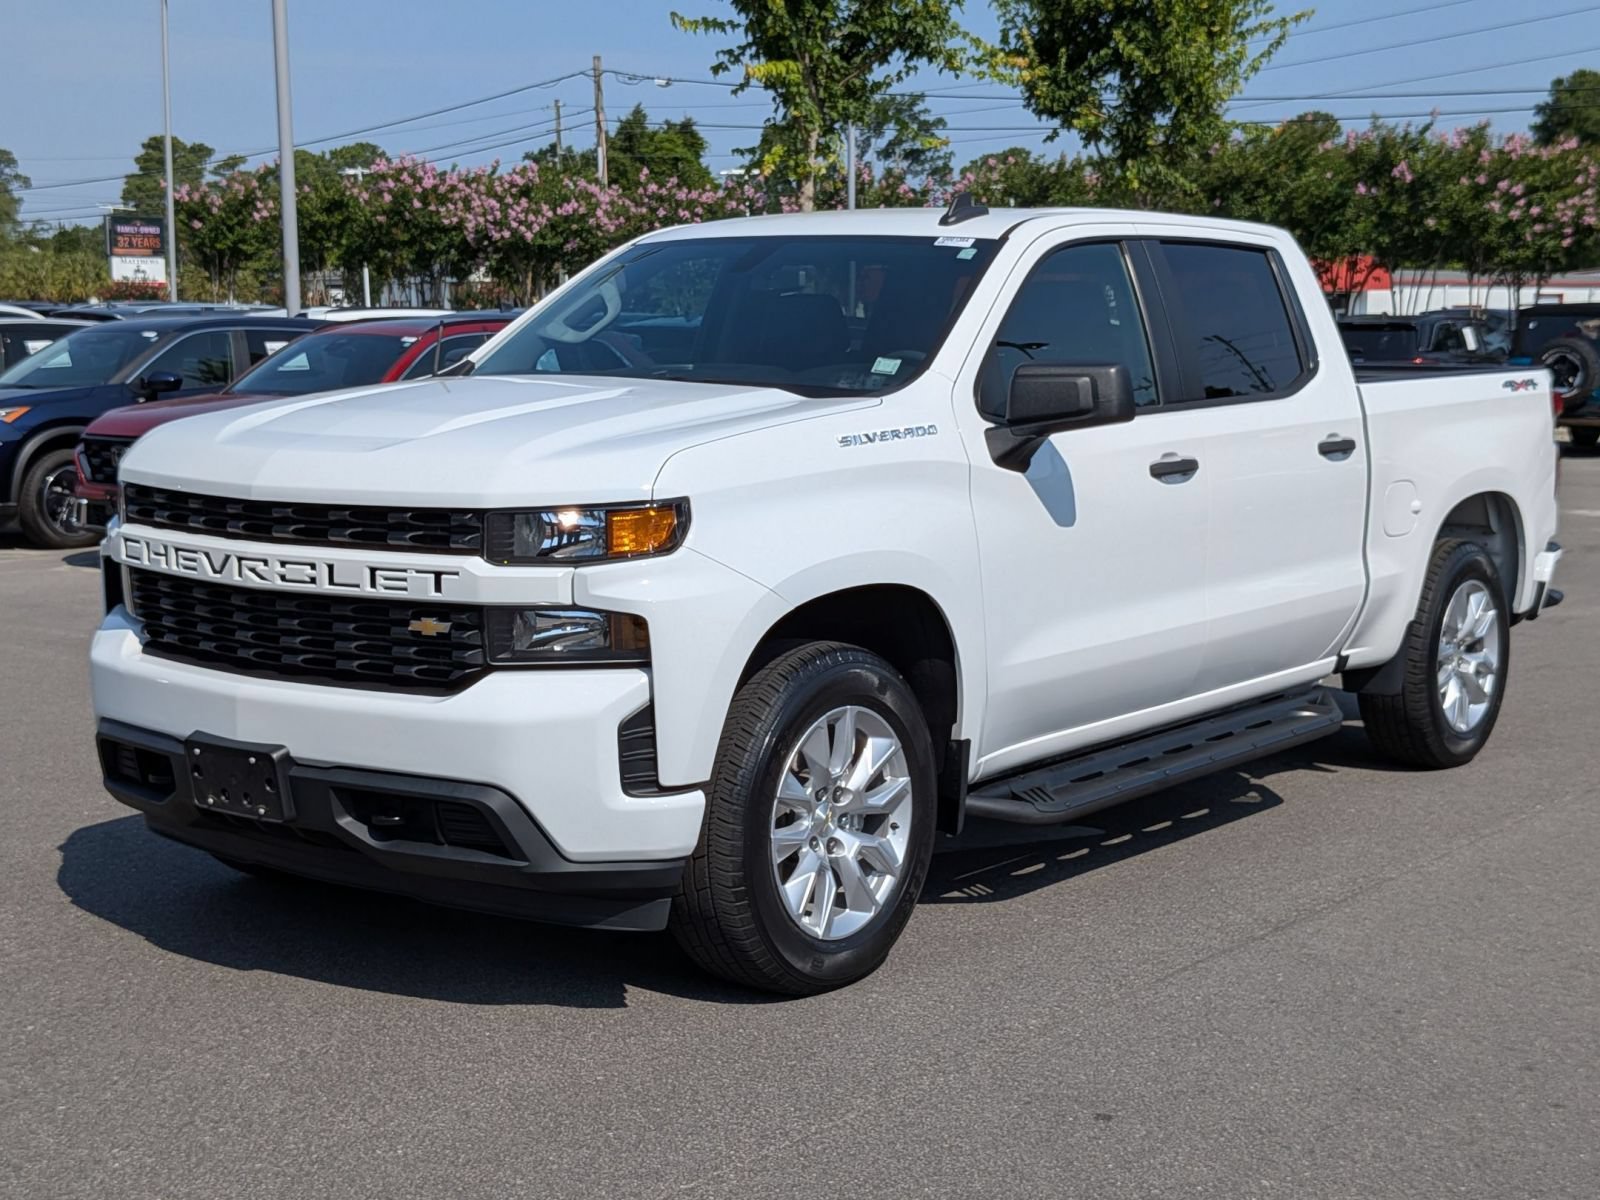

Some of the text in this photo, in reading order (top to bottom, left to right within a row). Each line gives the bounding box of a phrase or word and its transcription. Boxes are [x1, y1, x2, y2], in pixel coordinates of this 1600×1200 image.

[118, 236, 161, 248] 32 YEARS
[838, 424, 938, 448] SILVERADO
[121, 536, 460, 597] CHEVROLET
